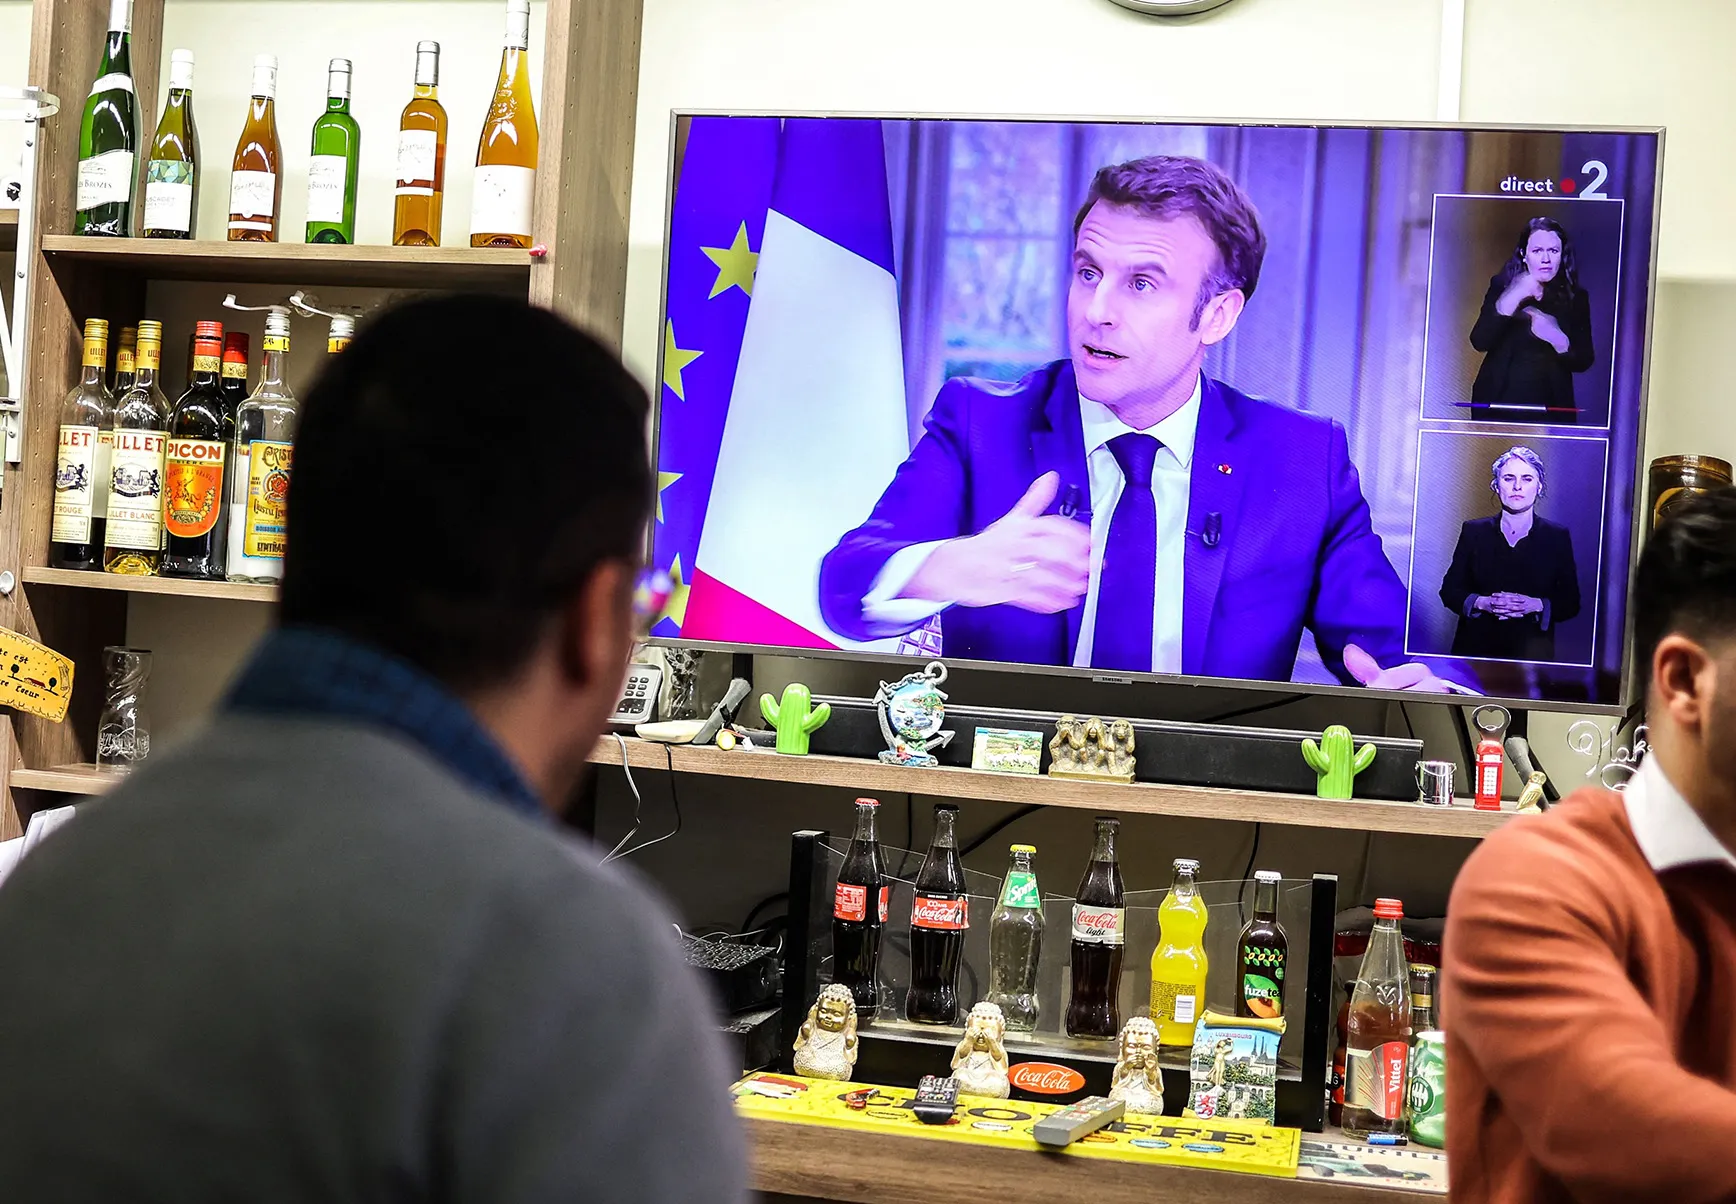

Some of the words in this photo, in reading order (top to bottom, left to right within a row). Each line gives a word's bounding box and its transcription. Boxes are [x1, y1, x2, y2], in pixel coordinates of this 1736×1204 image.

[1500, 177, 1553, 192] direct
[1579, 160, 1608, 199] 2
[60, 431, 91, 447] LET
[168, 443, 221, 460] PICON
[60, 505, 83, 514] ROUGE
[130, 511, 155, 520] BLANC
[14, 655, 29, 664] est
[919, 906, 956, 922] Coca-Cola
[1077, 910, 1118, 930] Coca-Cola
[1085, 926, 1106, 937] light
[1215, 1032, 1253, 1040] LUXEMBOURG
[1013, 1067, 1074, 1091] Coca-Cola
[1388, 1059, 1402, 1093] Vittel
